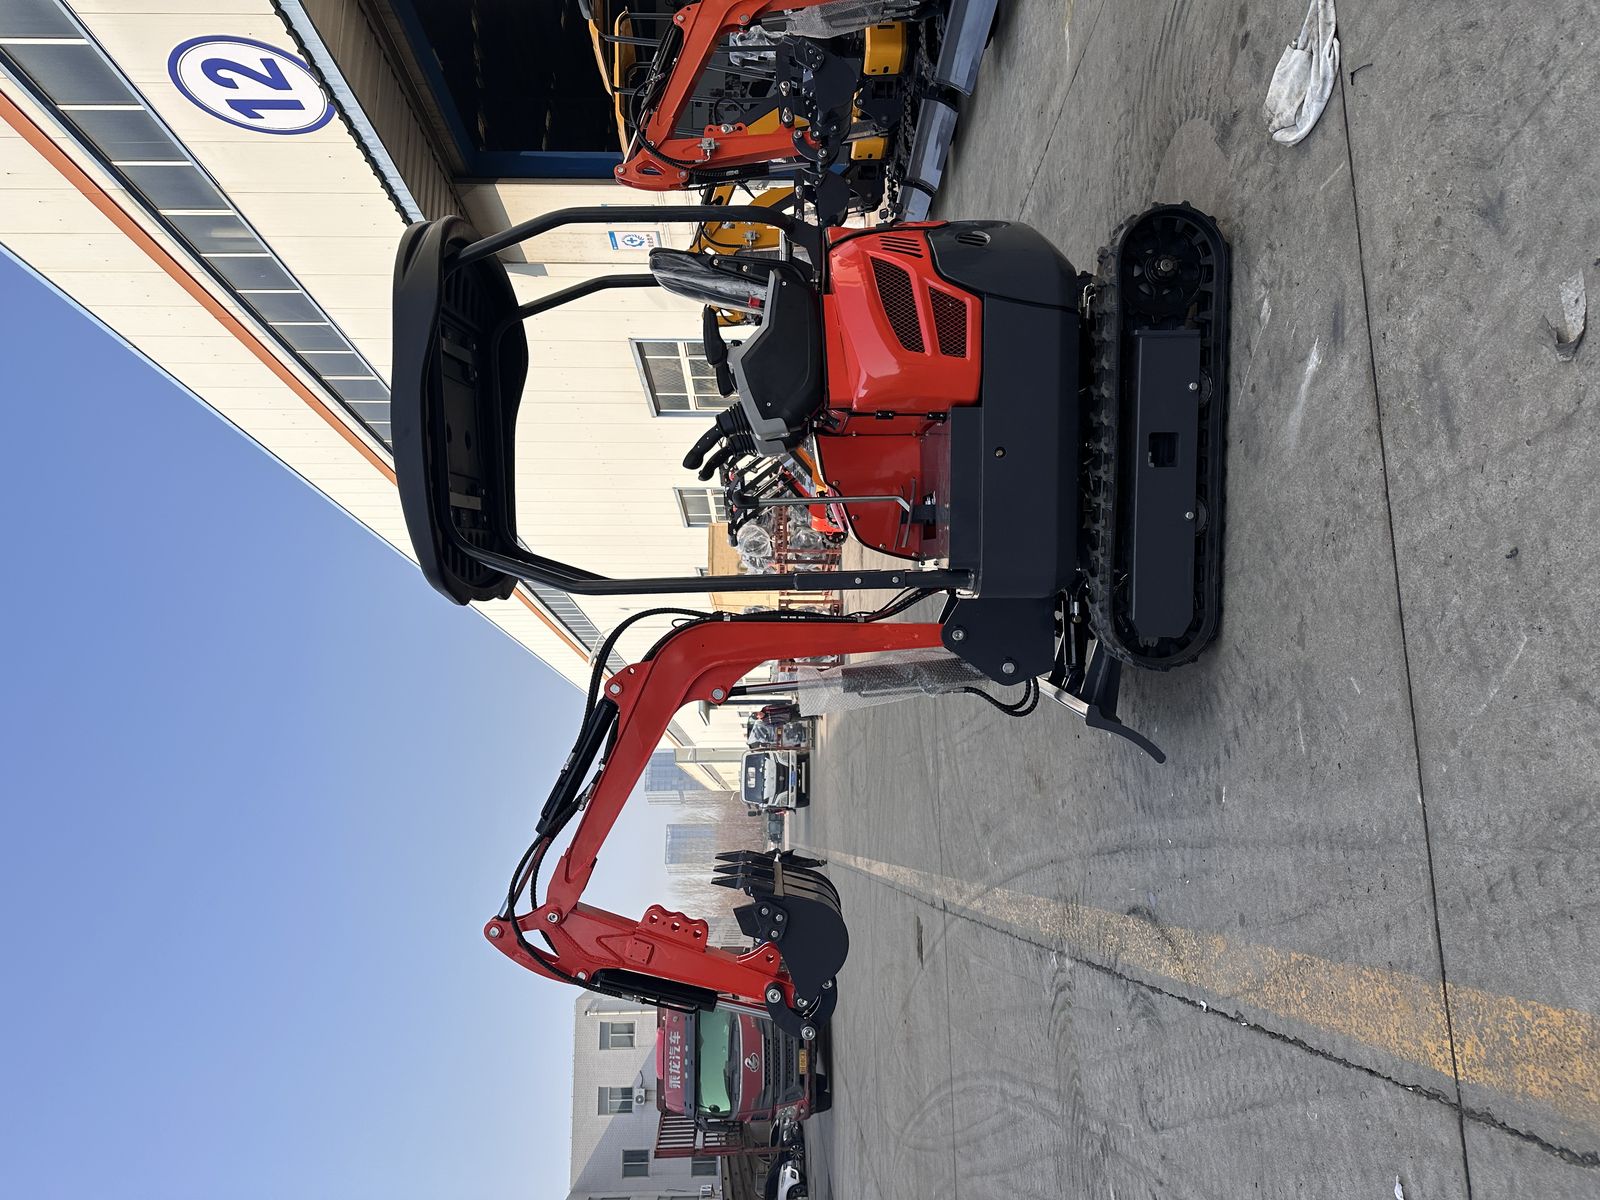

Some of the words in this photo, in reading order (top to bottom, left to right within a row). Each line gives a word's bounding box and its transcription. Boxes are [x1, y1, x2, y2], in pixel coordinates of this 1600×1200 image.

[201, 58, 305, 119] 12
[669, 1031, 681, 1089] 乘龙汽车
